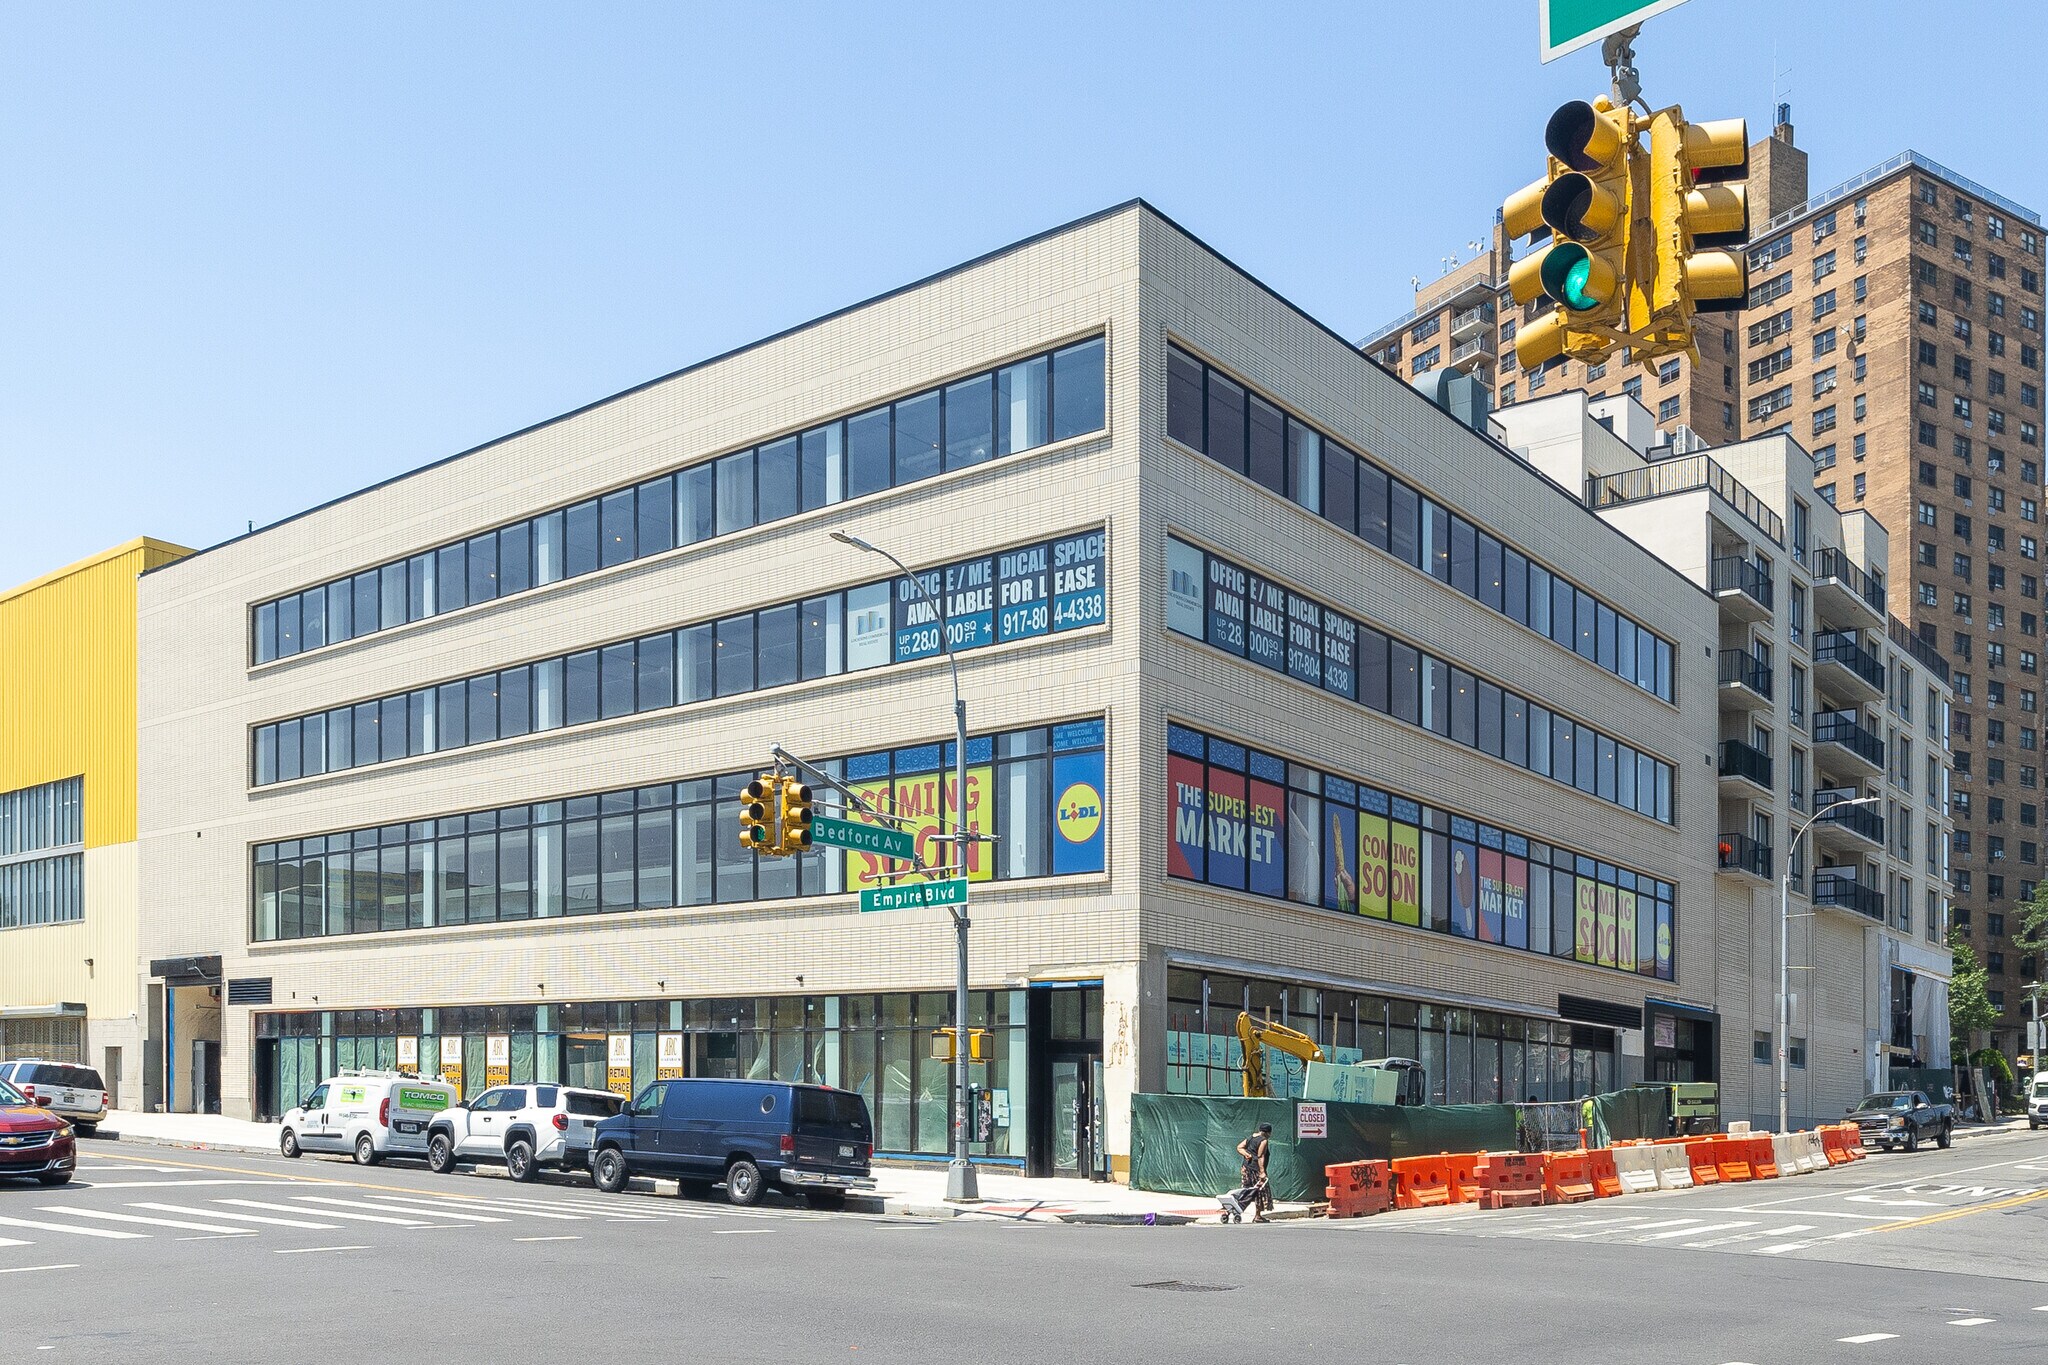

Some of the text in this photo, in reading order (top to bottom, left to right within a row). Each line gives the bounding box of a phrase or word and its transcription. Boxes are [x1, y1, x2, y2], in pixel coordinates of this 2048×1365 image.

[1001, 577, 1033, 606] FOR
[964, 620, 977, 631] SQ
[1216, 617, 1227, 628] UP
[1324, 609, 1356, 644] SPACE
[899, 635, 911, 645] UP
[965, 632, 976, 643] FT
[1217, 629, 1227, 641] TO
[1289, 621, 1312, 650] FOR
[899, 645, 911, 656] TO
[1269, 639, 1279, 651] SQ
[1269, 650, 1278, 661] FT
[1175, 781, 1202, 808] THE
[815, 822, 902, 852] Bedford Av
[1175, 806, 1275, 865] MARKET
[1362, 834, 1416, 869] COMING
[1362, 861, 1416, 905] SOON
[1480, 876, 1491, 890] THE
[873, 886, 955, 908] Empire Blvd
[1580, 884, 1632, 921] COMING
[1480, 889, 1524, 919] MARKET
[1580, 916, 1632, 966] SOON
[487, 1066, 508, 1076] RETAIL
[609, 1068, 630, 1079] RETAIL
[659, 1068, 681, 1079] RETAIL
[446, 1076, 461, 1085] PACE
[609, 1082, 630, 1093] SPACE
[404, 1091, 445, 1101] TOMCO
[1300, 1113, 1325, 1123] CLOSED
